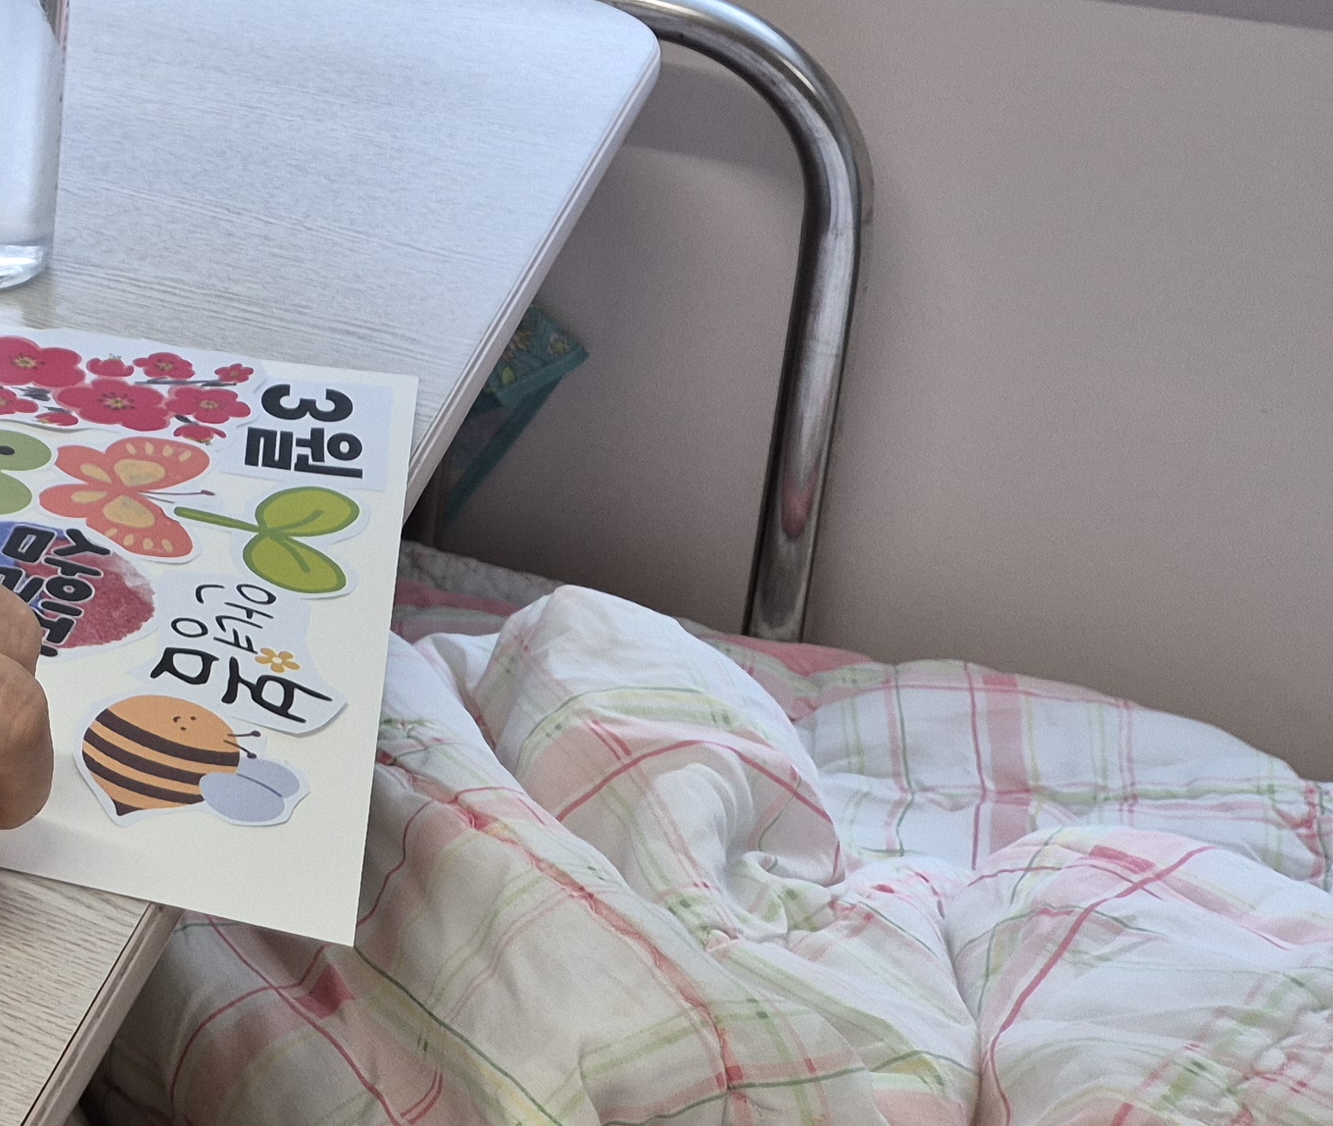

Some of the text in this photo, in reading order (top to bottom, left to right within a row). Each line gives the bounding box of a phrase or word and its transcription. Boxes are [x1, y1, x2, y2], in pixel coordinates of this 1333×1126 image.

[243, 383, 363, 480] 3월
[172, 583, 277, 654] 안녕
[150, 646, 333, 724] 봄
